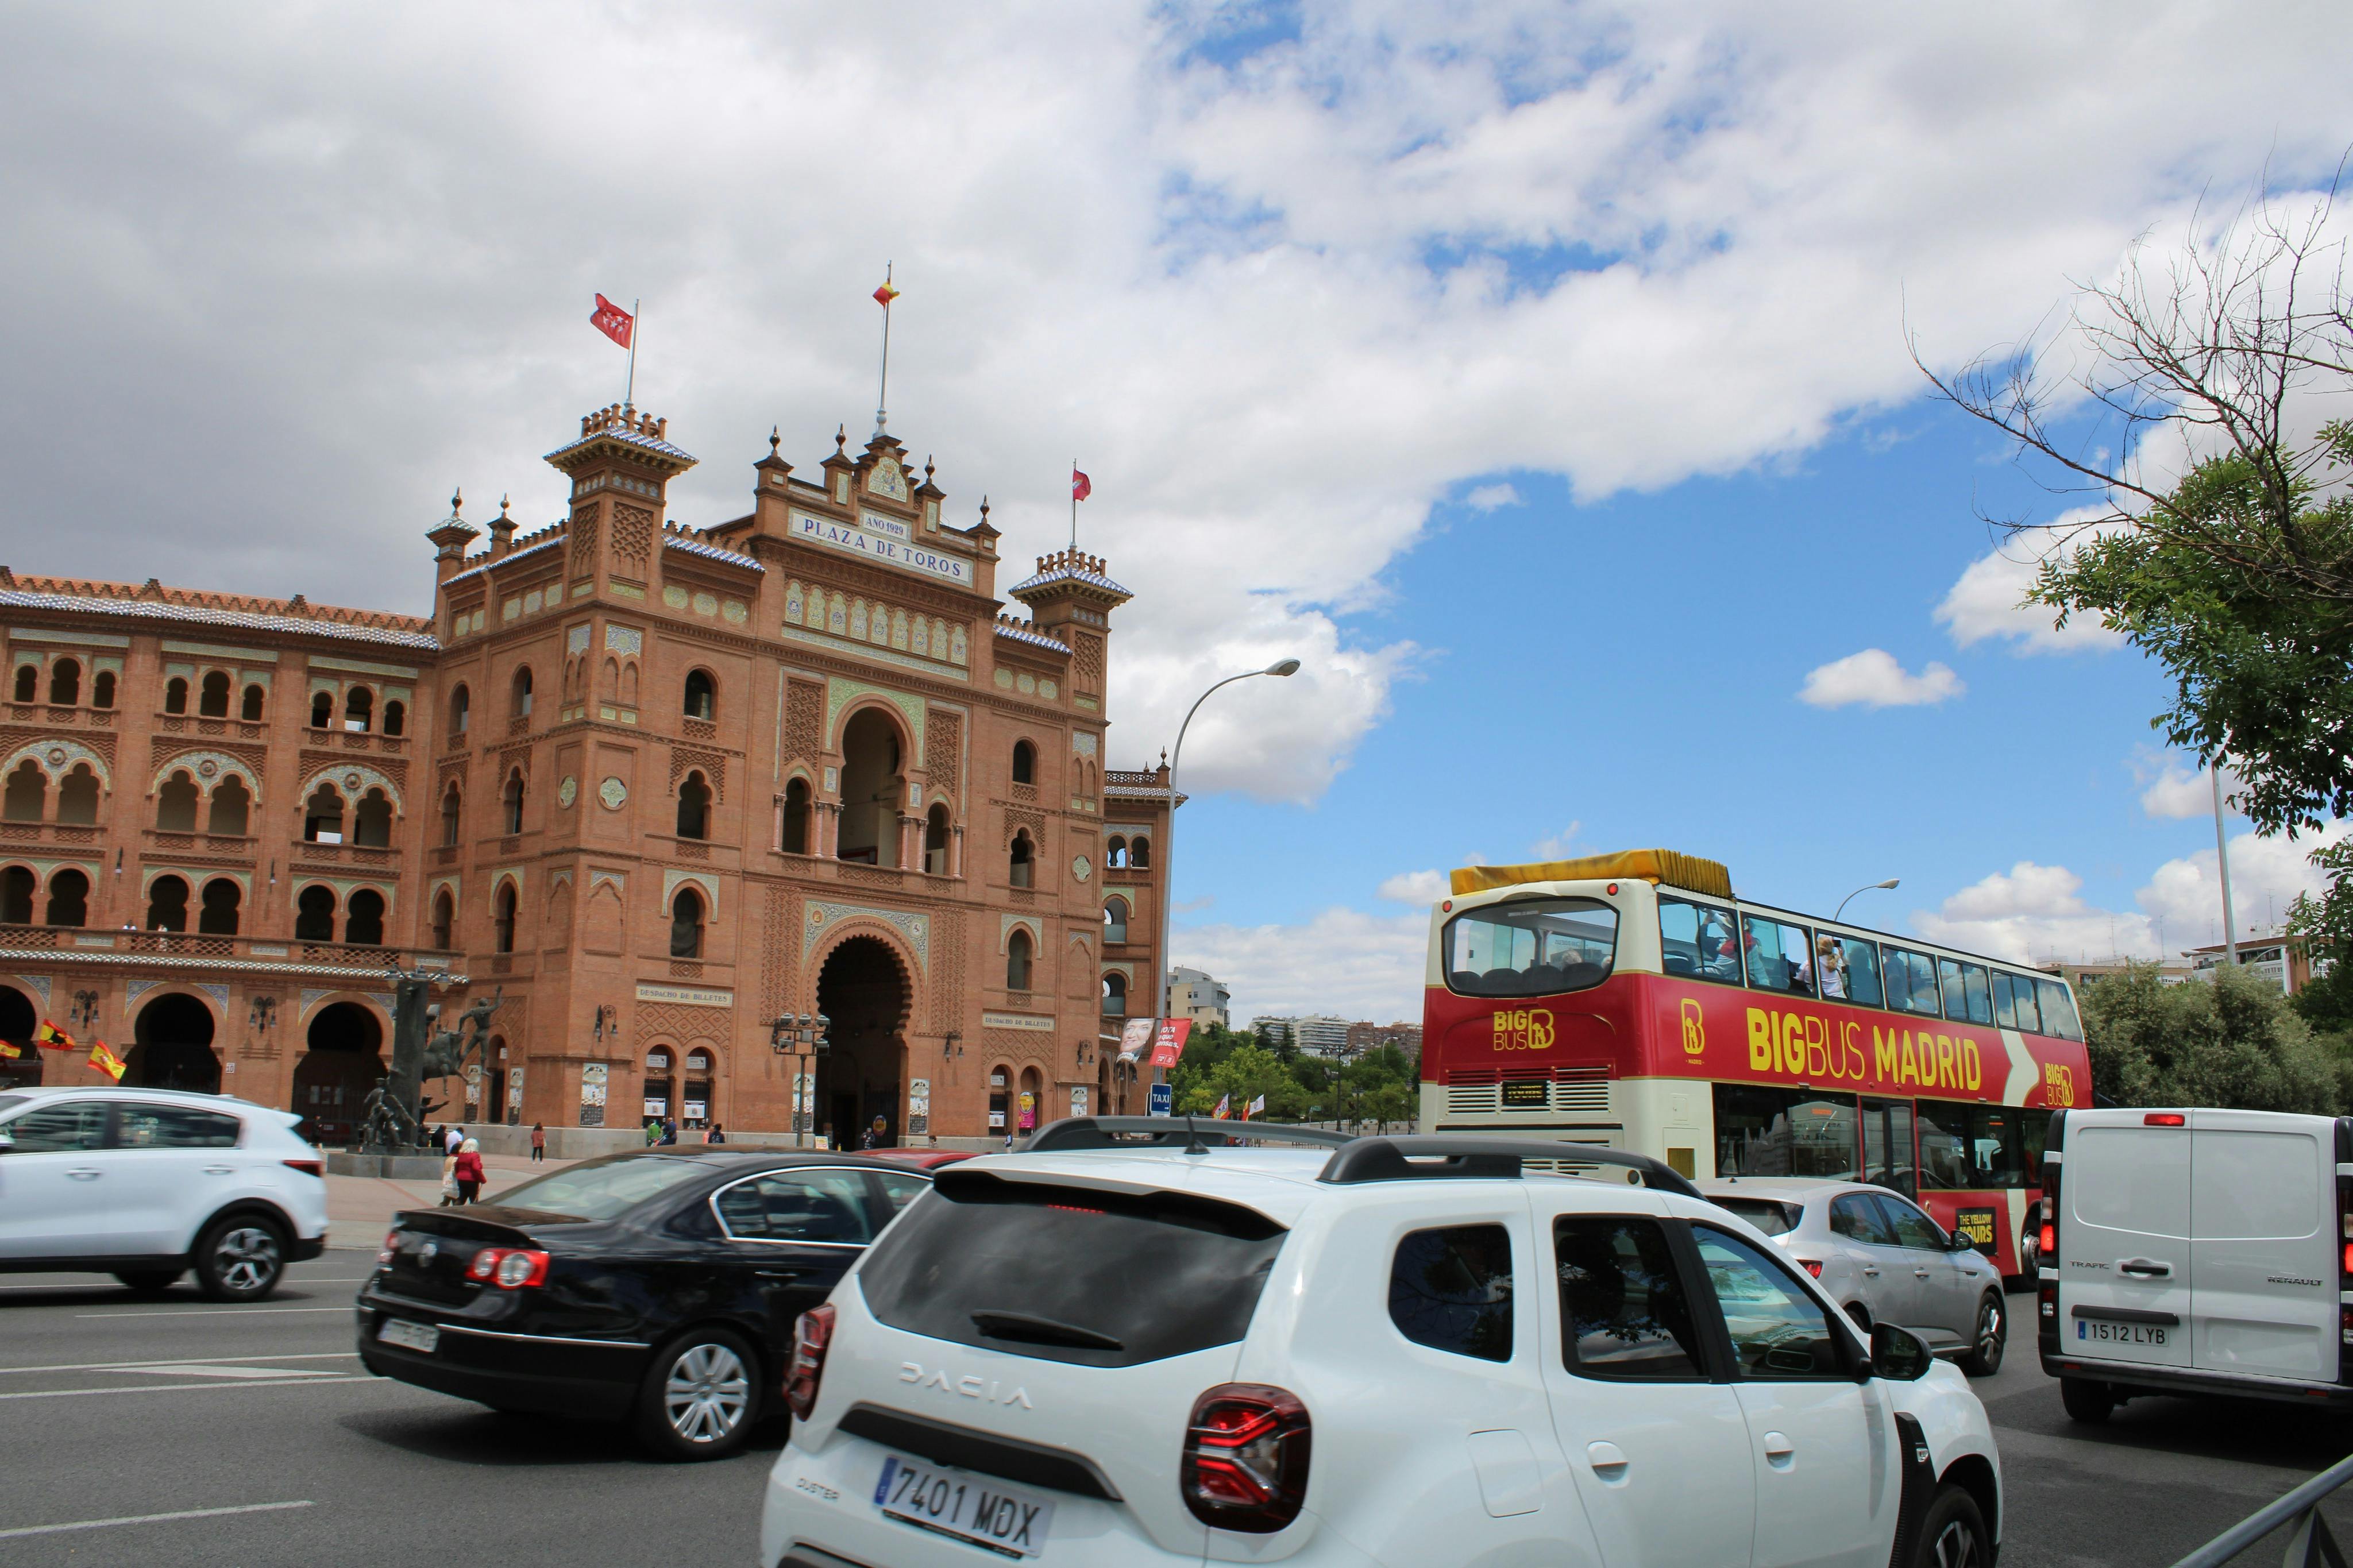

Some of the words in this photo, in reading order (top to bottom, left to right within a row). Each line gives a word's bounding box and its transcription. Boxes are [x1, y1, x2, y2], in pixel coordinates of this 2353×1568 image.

[866, 516, 884, 530] AÑO
[886, 522, 904, 536] 1929
[804, 518, 866, 550] PLAZA
[877, 540, 896, 557] DE
[904, 548, 961, 576] TOROS
[640, 989, 677, 998] DESPACHO
[693, 994, 727, 1002] BILLETES
[1494, 1010, 1527, 1032] BIG
[1494, 1032, 1527, 1051] BUS
[1873, 1025, 1981, 1091] MADRID
[2045, 1063, 2061, 1086] BIG
[1152, 1094, 1170, 1103] TAXI
[2047, 1086, 2063, 1106] BUS
[1959, 1215, 1970, 1225] THE
[1970, 1214, 1992, 1225] YELLOW
[1959, 1225, 1993, 1243] OURS
[2070, 1260, 2110, 1270] TRAFIC
[2267, 1275, 2324, 1287] RENAULT
[2092, 1324, 2129, 1341] 1512
[2135, 1327, 2165, 1344] LYB
[899, 1362, 1033, 1409] DACIA
[796, 1476, 839, 1500] DUSTER
[892, 1467, 967, 1524] 7401
[973, 1490, 1040, 1546] MDX
